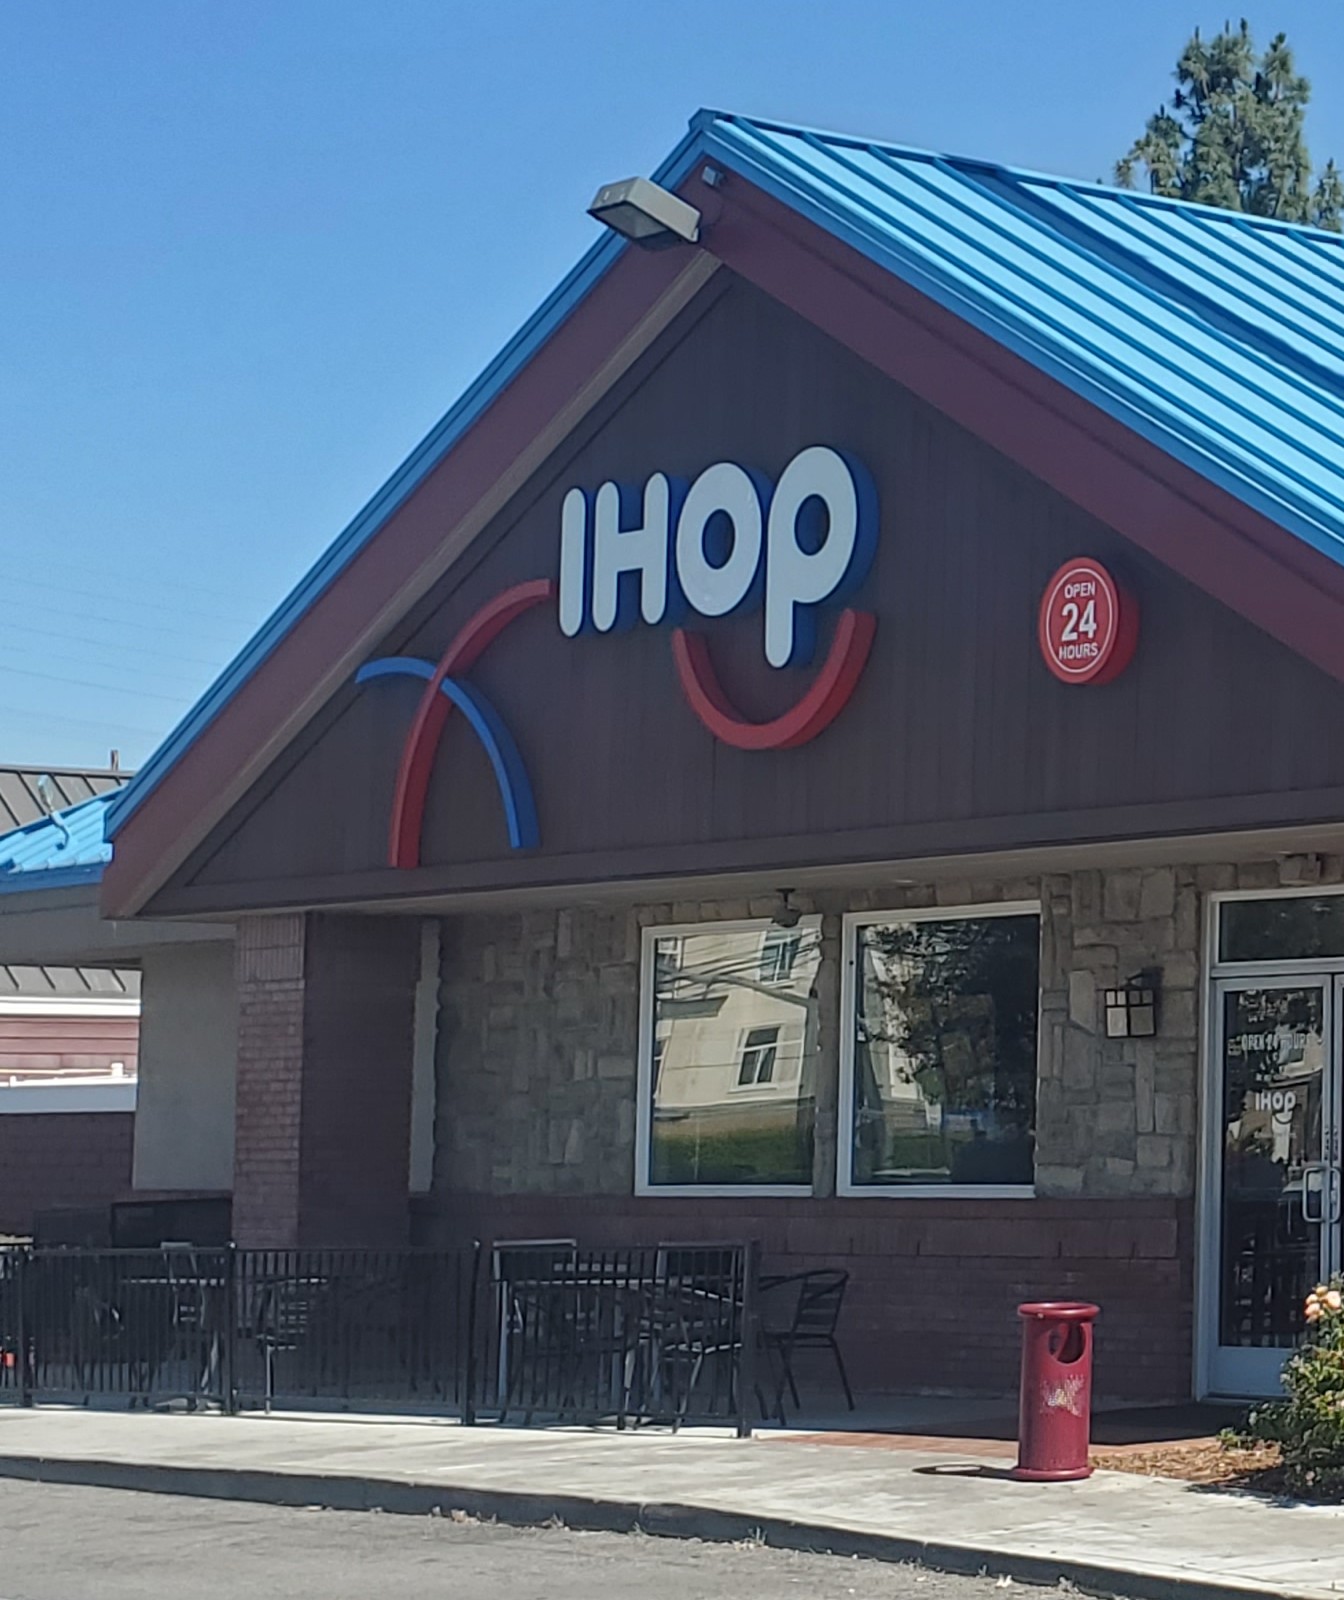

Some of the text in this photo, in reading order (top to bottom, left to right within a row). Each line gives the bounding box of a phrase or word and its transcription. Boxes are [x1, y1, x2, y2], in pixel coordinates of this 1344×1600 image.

[558, 444, 872, 670] IHOP
[1064, 581, 1096, 599] OPEN
[1061, 599, 1097, 642] 24
[1058, 642, 1099, 660] HOURS
[1241, 1033, 1265, 1051] OPEN
[1255, 1090, 1297, 1114] IHOP
